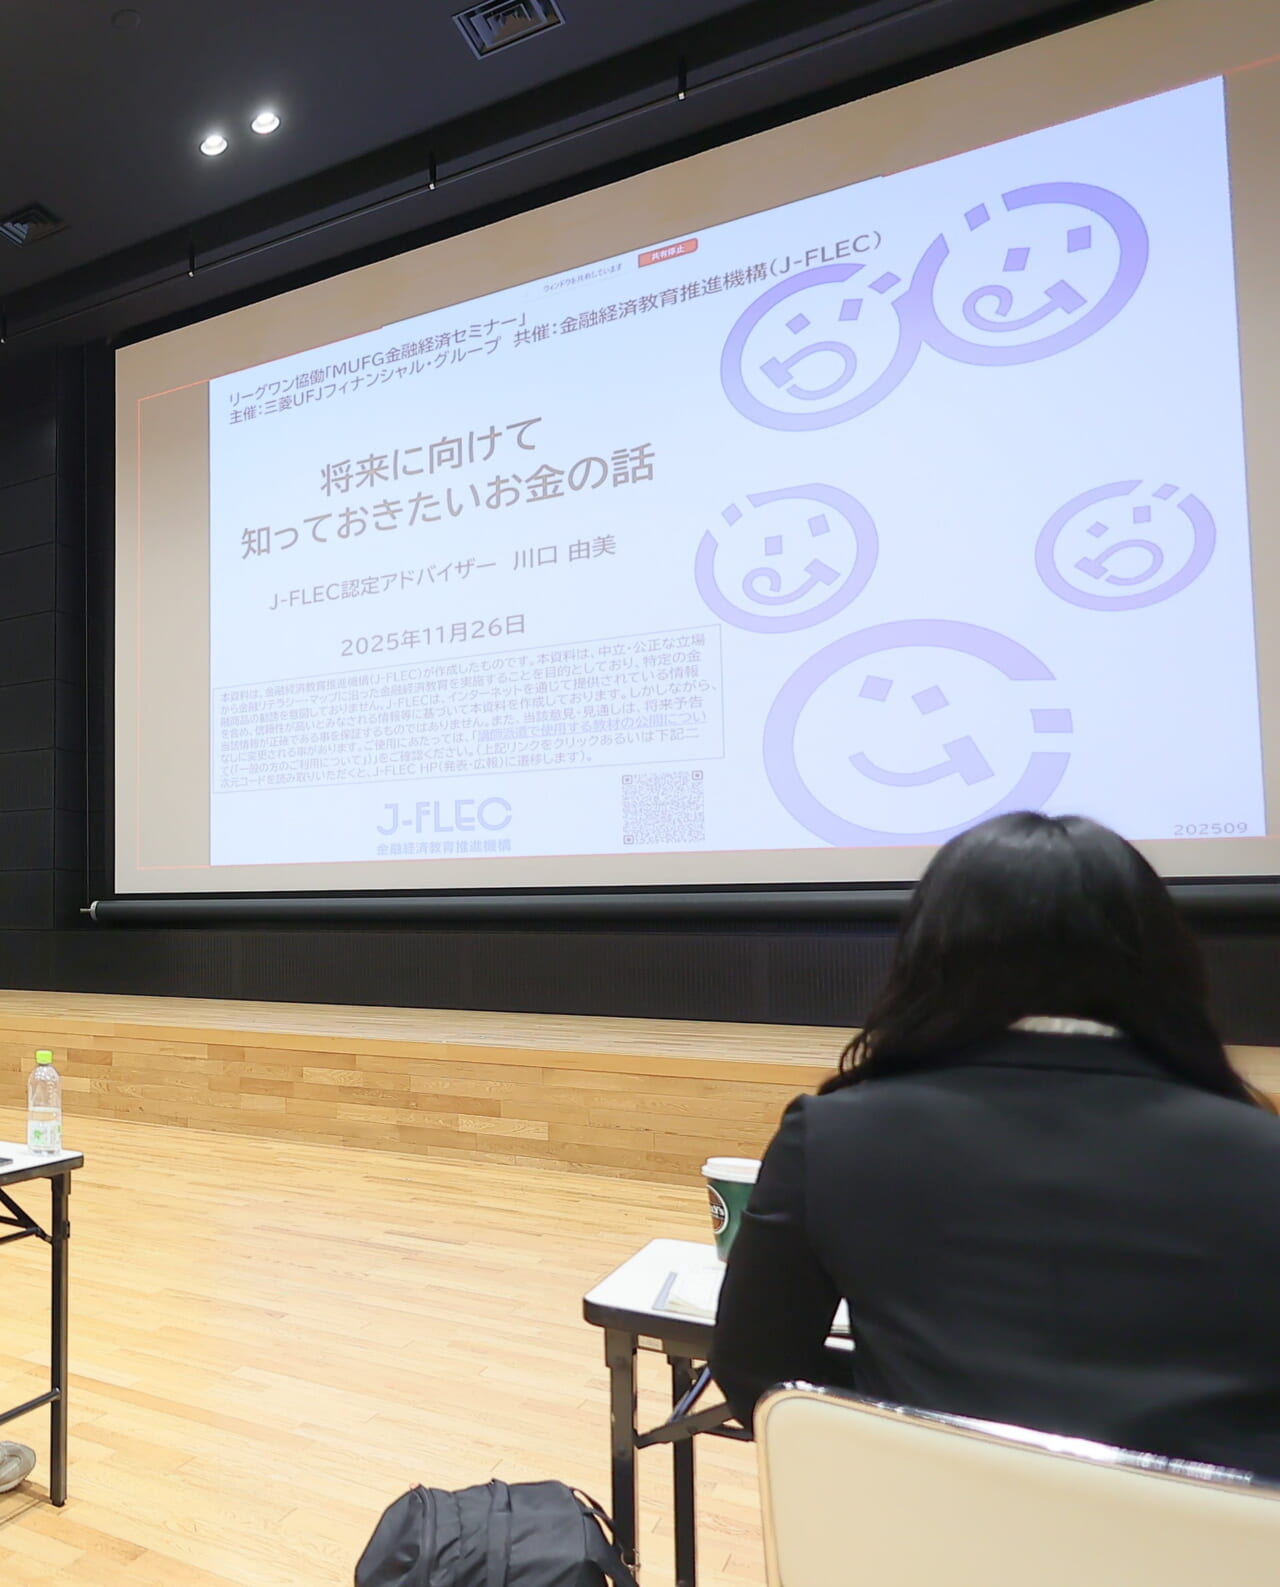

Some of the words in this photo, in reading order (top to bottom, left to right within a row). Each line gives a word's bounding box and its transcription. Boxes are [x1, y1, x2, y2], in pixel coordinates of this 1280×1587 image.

[228, 311, 526, 406] リーグワン協働「MUFG金融経済セミナー」
[321, 417, 542, 497] 将来に向けて
[241, 442, 656, 559] 知っておきたいお金の話
[269, 557, 497, 610] J-FLEC認定アドバイザー
[513, 545, 559, 571] 川口
[568, 534, 618, 563] 由美
[340, 614, 526, 657] 2025年11月26日
[376, 797, 513, 836] J-FLEC
[1173, 822, 1248, 836] 202509
[375, 838, 513, 855] 金融経済教育推進機構
